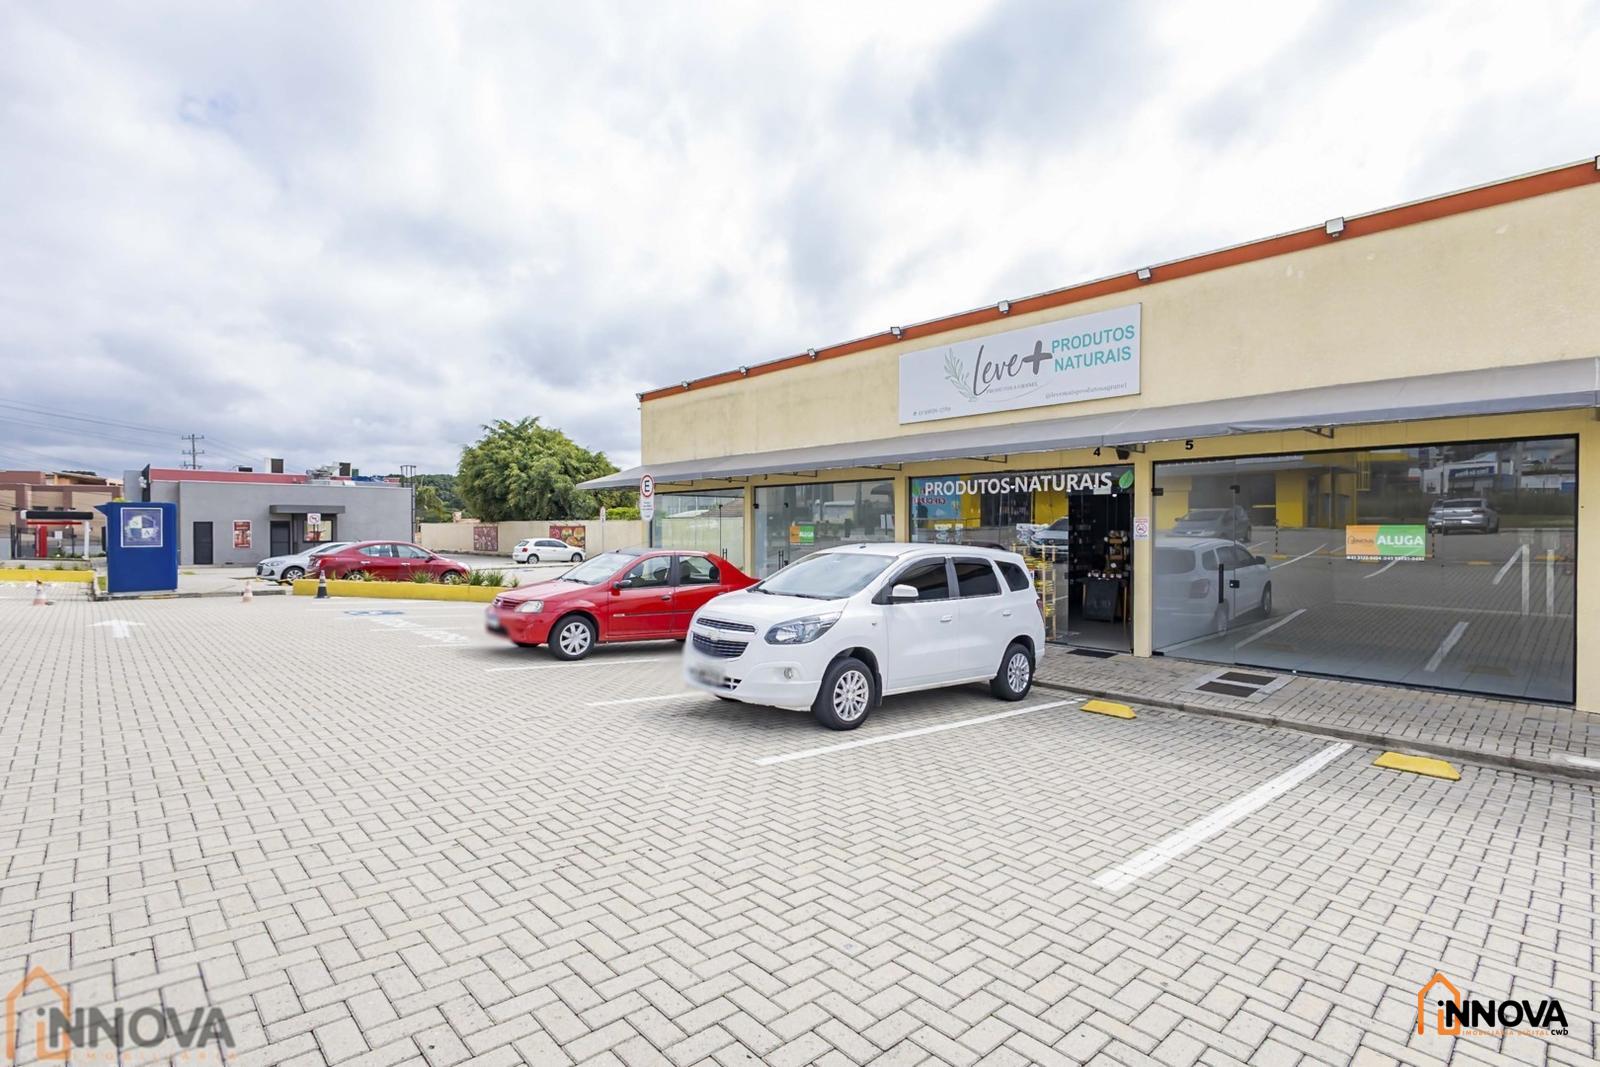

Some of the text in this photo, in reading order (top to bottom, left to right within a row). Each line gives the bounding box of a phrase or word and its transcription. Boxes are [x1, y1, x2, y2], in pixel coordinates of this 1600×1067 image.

[1052, 325, 1135, 353] PRODUTOS
[1055, 346, 1132, 372] NATURAIS
[1185, 440, 1194, 450] 5
[1093, 447, 1101, 456] 4
[644, 480, 650, 492] E
[925, 472, 1113, 496] PRODUTOS NATURAIS
[1377, 535, 1424, 545] ALUGA
